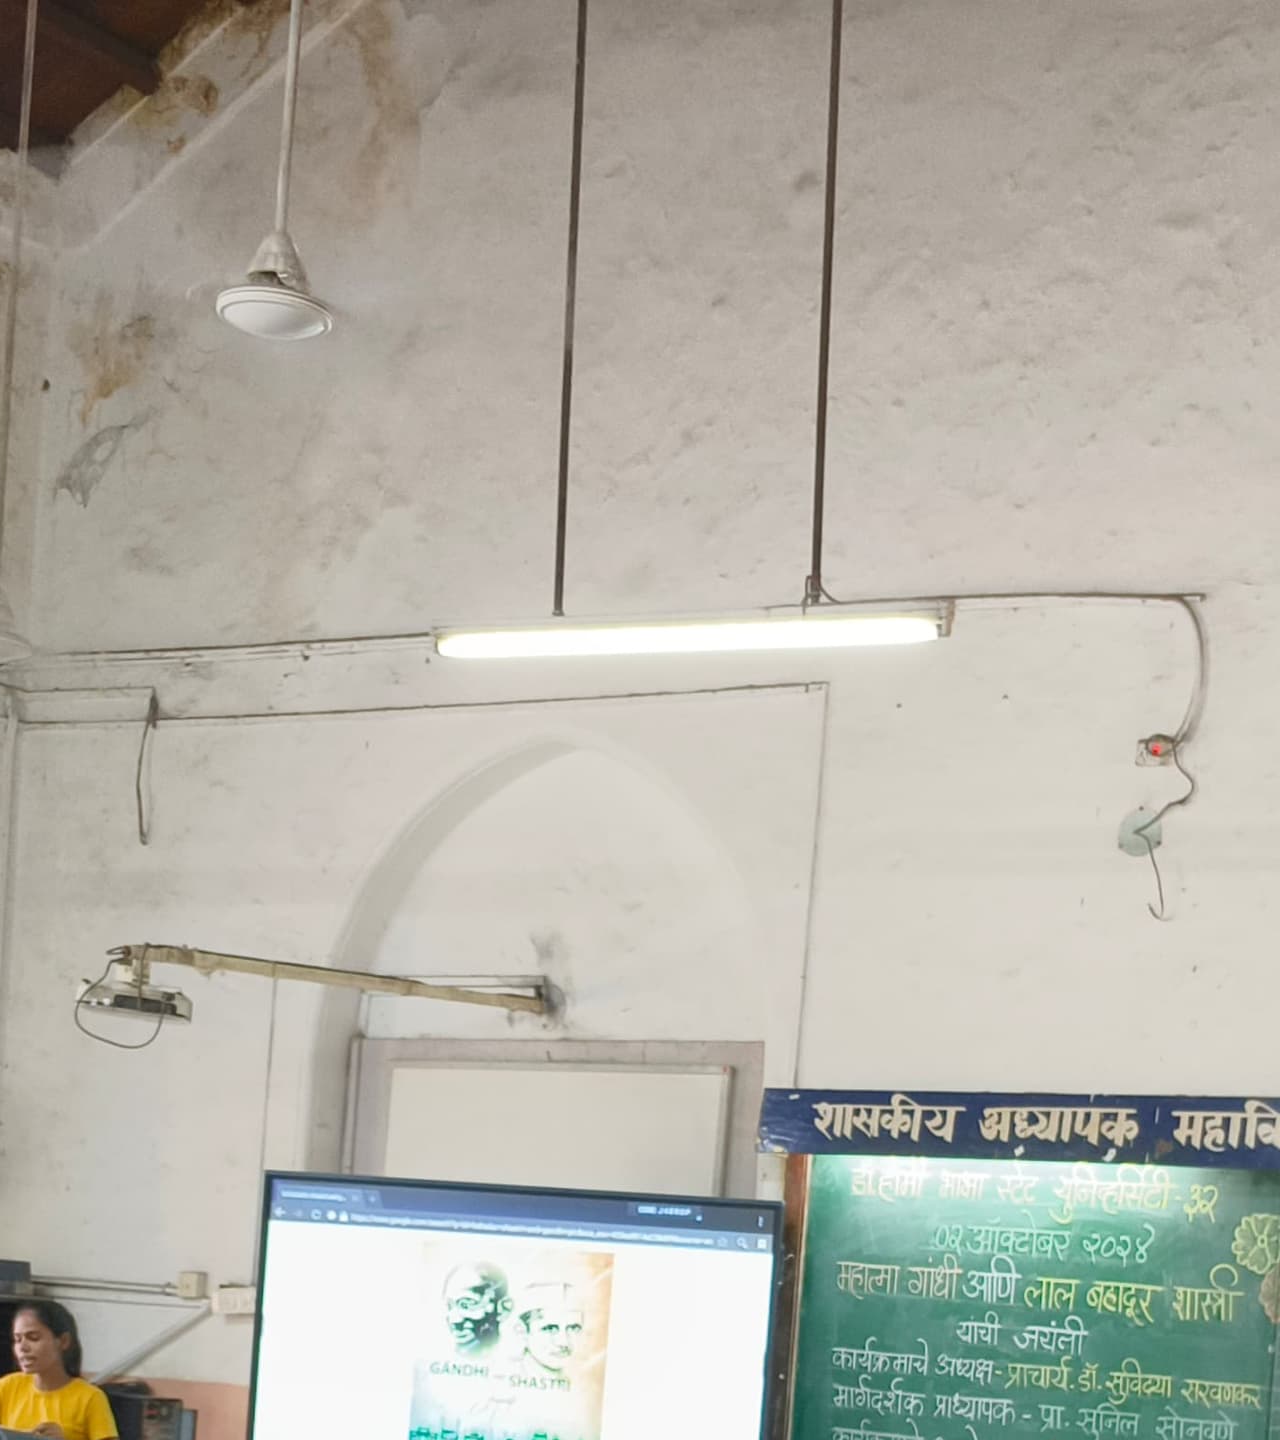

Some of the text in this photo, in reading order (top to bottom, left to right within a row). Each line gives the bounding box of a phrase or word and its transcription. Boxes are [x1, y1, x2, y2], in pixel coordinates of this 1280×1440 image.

[813, 1094, 967, 1143] शासकीय
[979, 1106, 1139, 1148] अध्यापक
[1082, 1223, 1156, 1268] २०२४
[835, 1254, 1246, 1327] महात्मा गांधी आणि लाल बहादूर शास्त्री
[832, 1336, 929, 1376] कार्यक्रमाचे
[1013, 1315, 1089, 1356] जयंती
[429, 1360, 572, 1393] GANDHI SHASTRI
[832, 1374, 927, 1417] मार्गदर्शक
[933, 1392, 1016, 1426] प्राध्यापक
